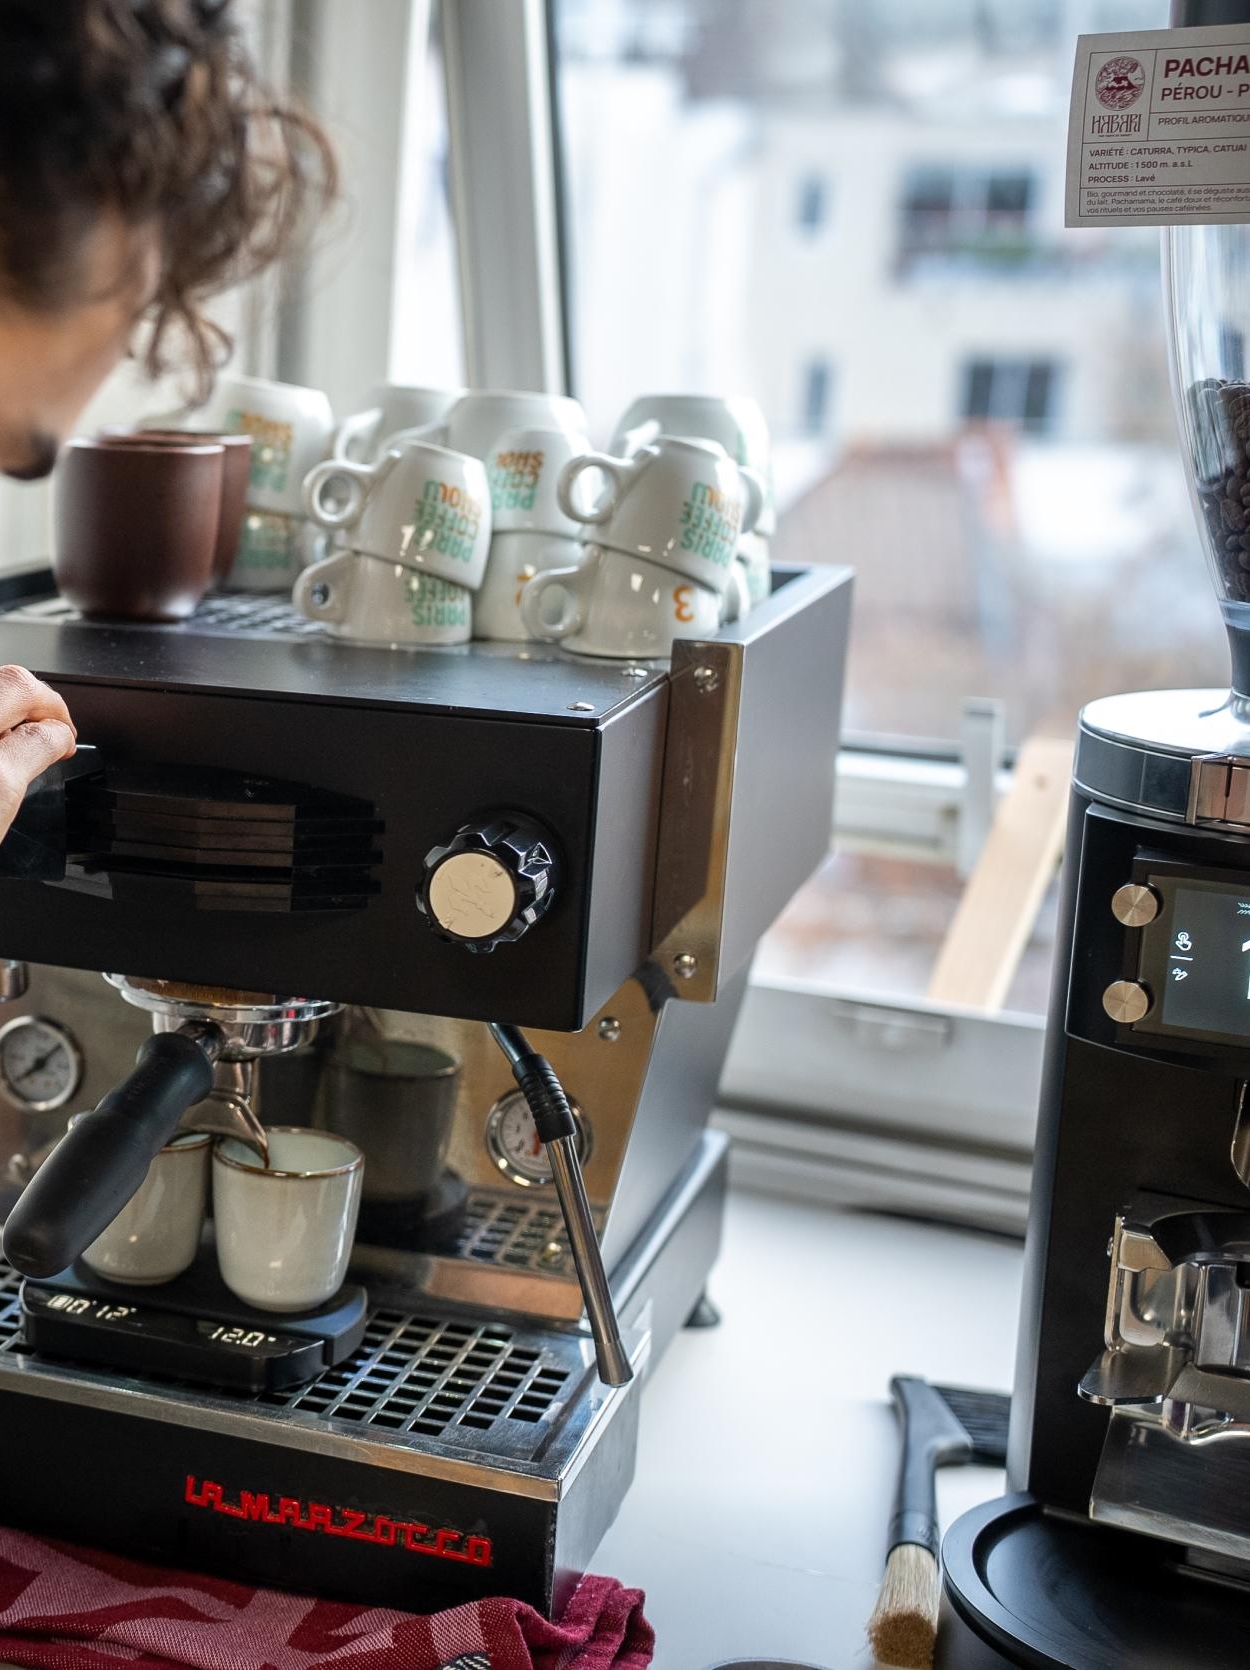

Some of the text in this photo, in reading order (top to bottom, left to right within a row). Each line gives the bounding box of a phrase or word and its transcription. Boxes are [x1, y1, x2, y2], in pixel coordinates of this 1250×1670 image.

[1161, 83, 1222, 101] PÉROU
[1158, 117, 1191, 126] PROFIL
[1089, 147, 1125, 157] VARIÉTÉ
[1089, 162, 1129, 170] ALTITUDE
[1087, 175, 1129, 183] PROCESS
[1135, 174, 1156, 182] Lavé
[1101, 190, 1138, 198] gourmand
[680, 526, 732, 567] PARIS
[210, 1326, 265, 1347] 12.0
[184, 1474, 493, 1568] LA MARZOCCO
